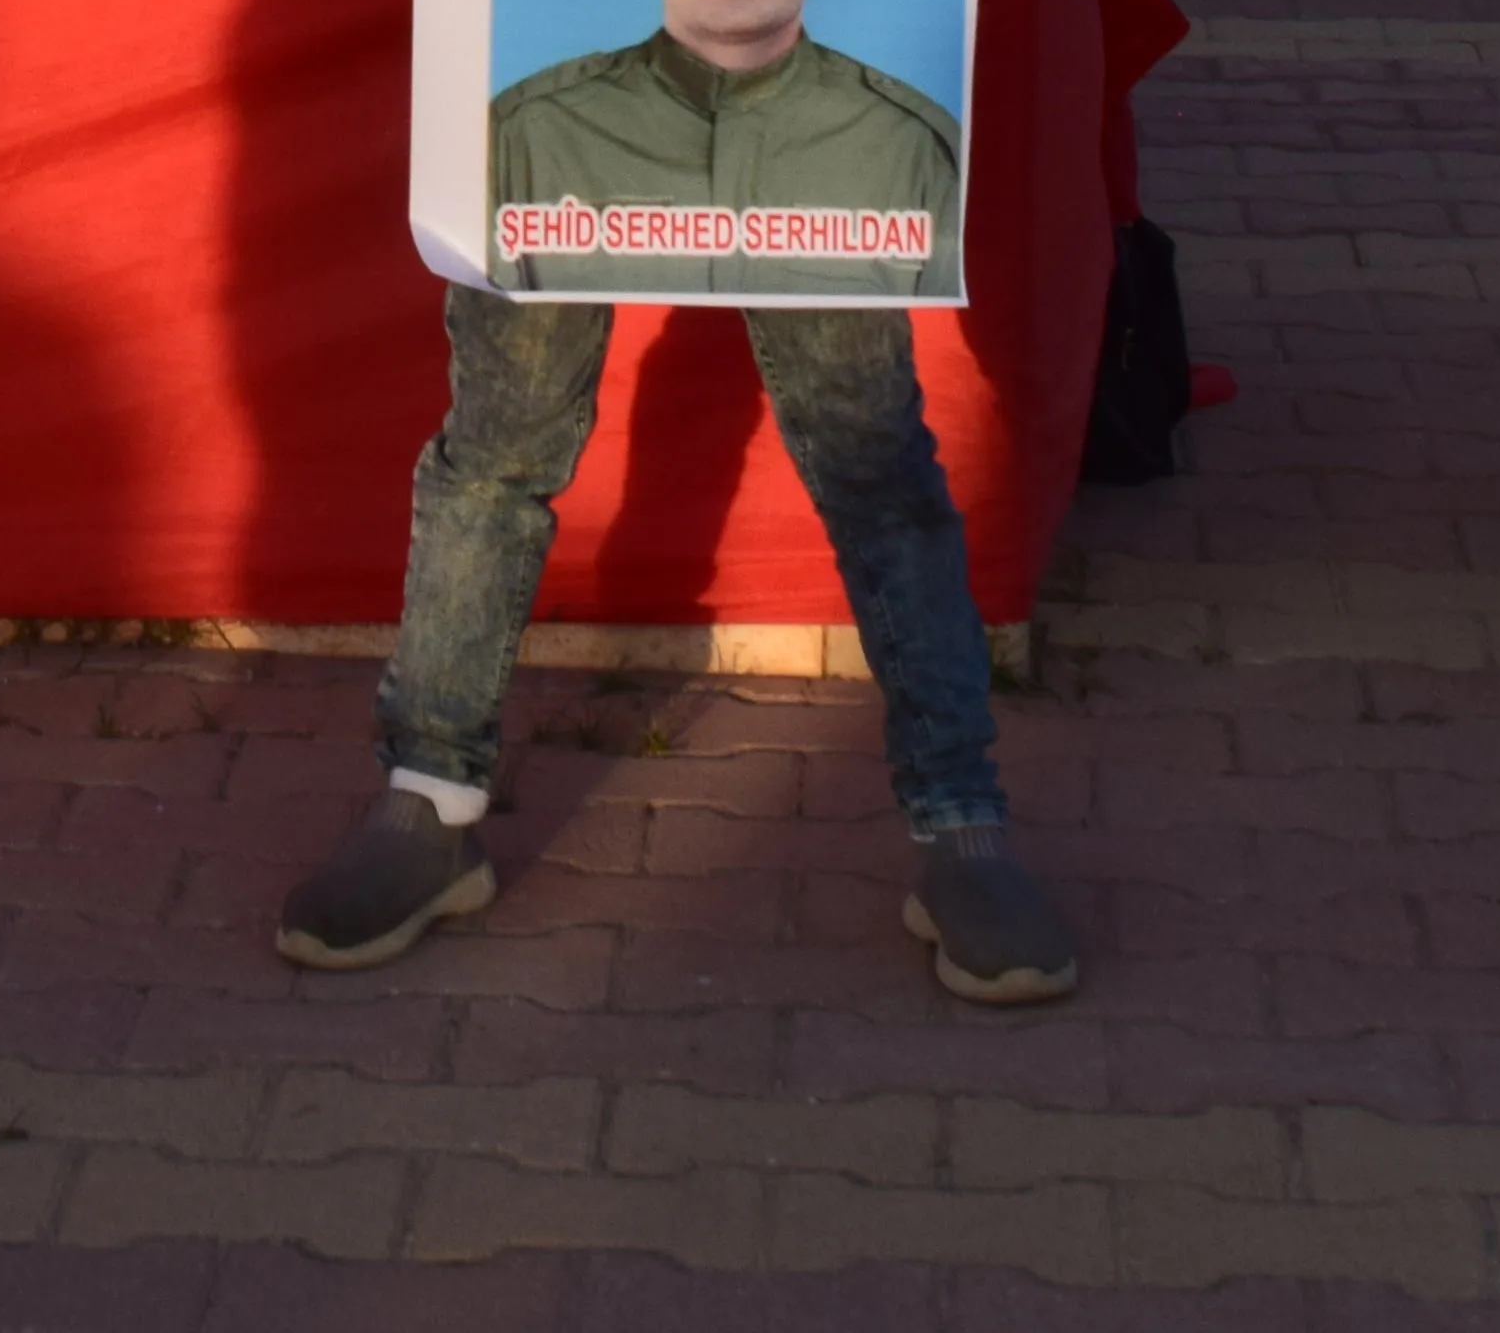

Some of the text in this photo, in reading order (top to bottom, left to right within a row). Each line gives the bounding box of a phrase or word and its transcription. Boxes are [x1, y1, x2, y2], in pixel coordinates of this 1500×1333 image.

[501, 200, 928, 254] ŞEHÎD SERHED SERHILDAN
